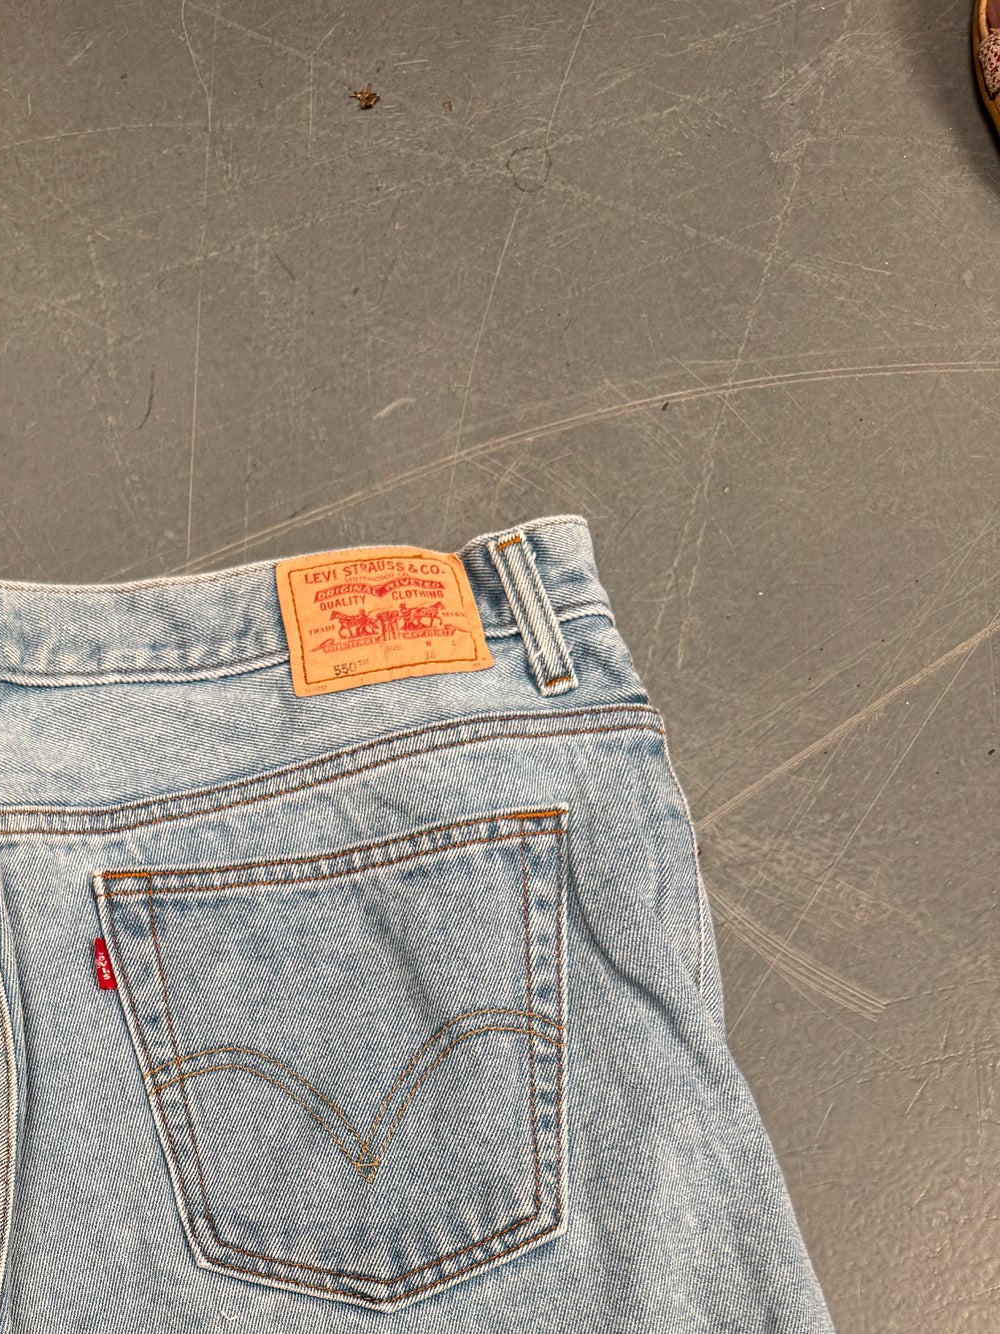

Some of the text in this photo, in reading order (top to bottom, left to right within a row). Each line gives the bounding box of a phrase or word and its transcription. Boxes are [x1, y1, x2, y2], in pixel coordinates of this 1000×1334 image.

[304, 569, 337, 585] LEVI
[343, 560, 404, 577] STRAUSS
[317, 585, 378, 600] ORIGINAL
[319, 590, 444, 611] QUALITY CLOTHING
[309, 624, 336, 636] TRADE
